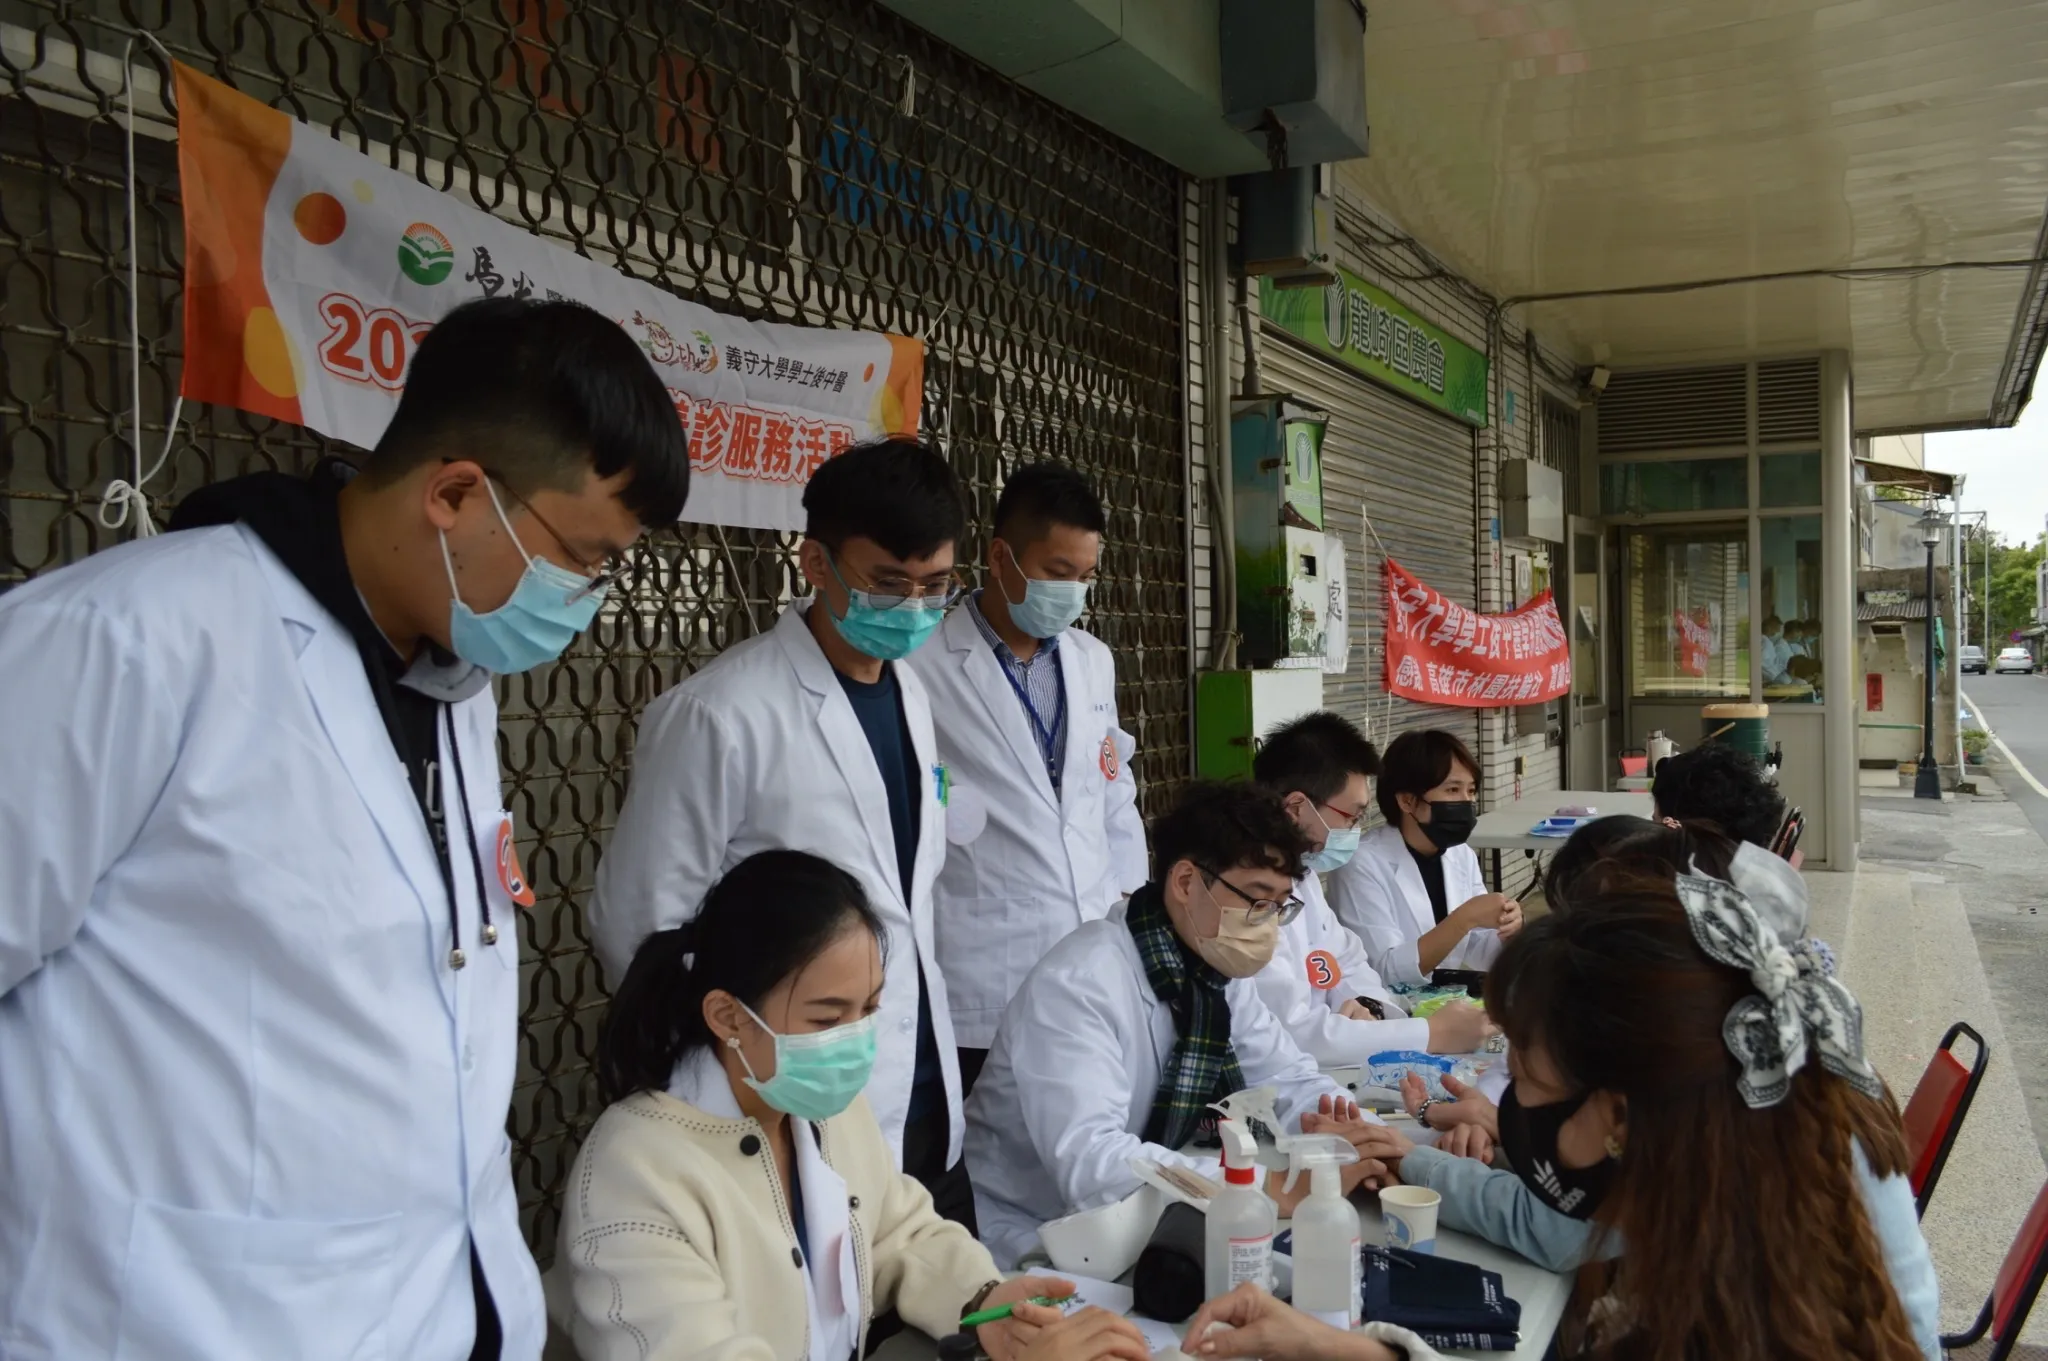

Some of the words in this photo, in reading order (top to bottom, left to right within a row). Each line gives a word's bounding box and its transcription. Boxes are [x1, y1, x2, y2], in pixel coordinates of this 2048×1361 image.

[322, 298, 432, 386] 20
[725, 345, 849, 394] 義守大學學士後中醫
[1349, 288, 1445, 393] 龍崎區農會
[1311, 956, 1332, 986] 3
